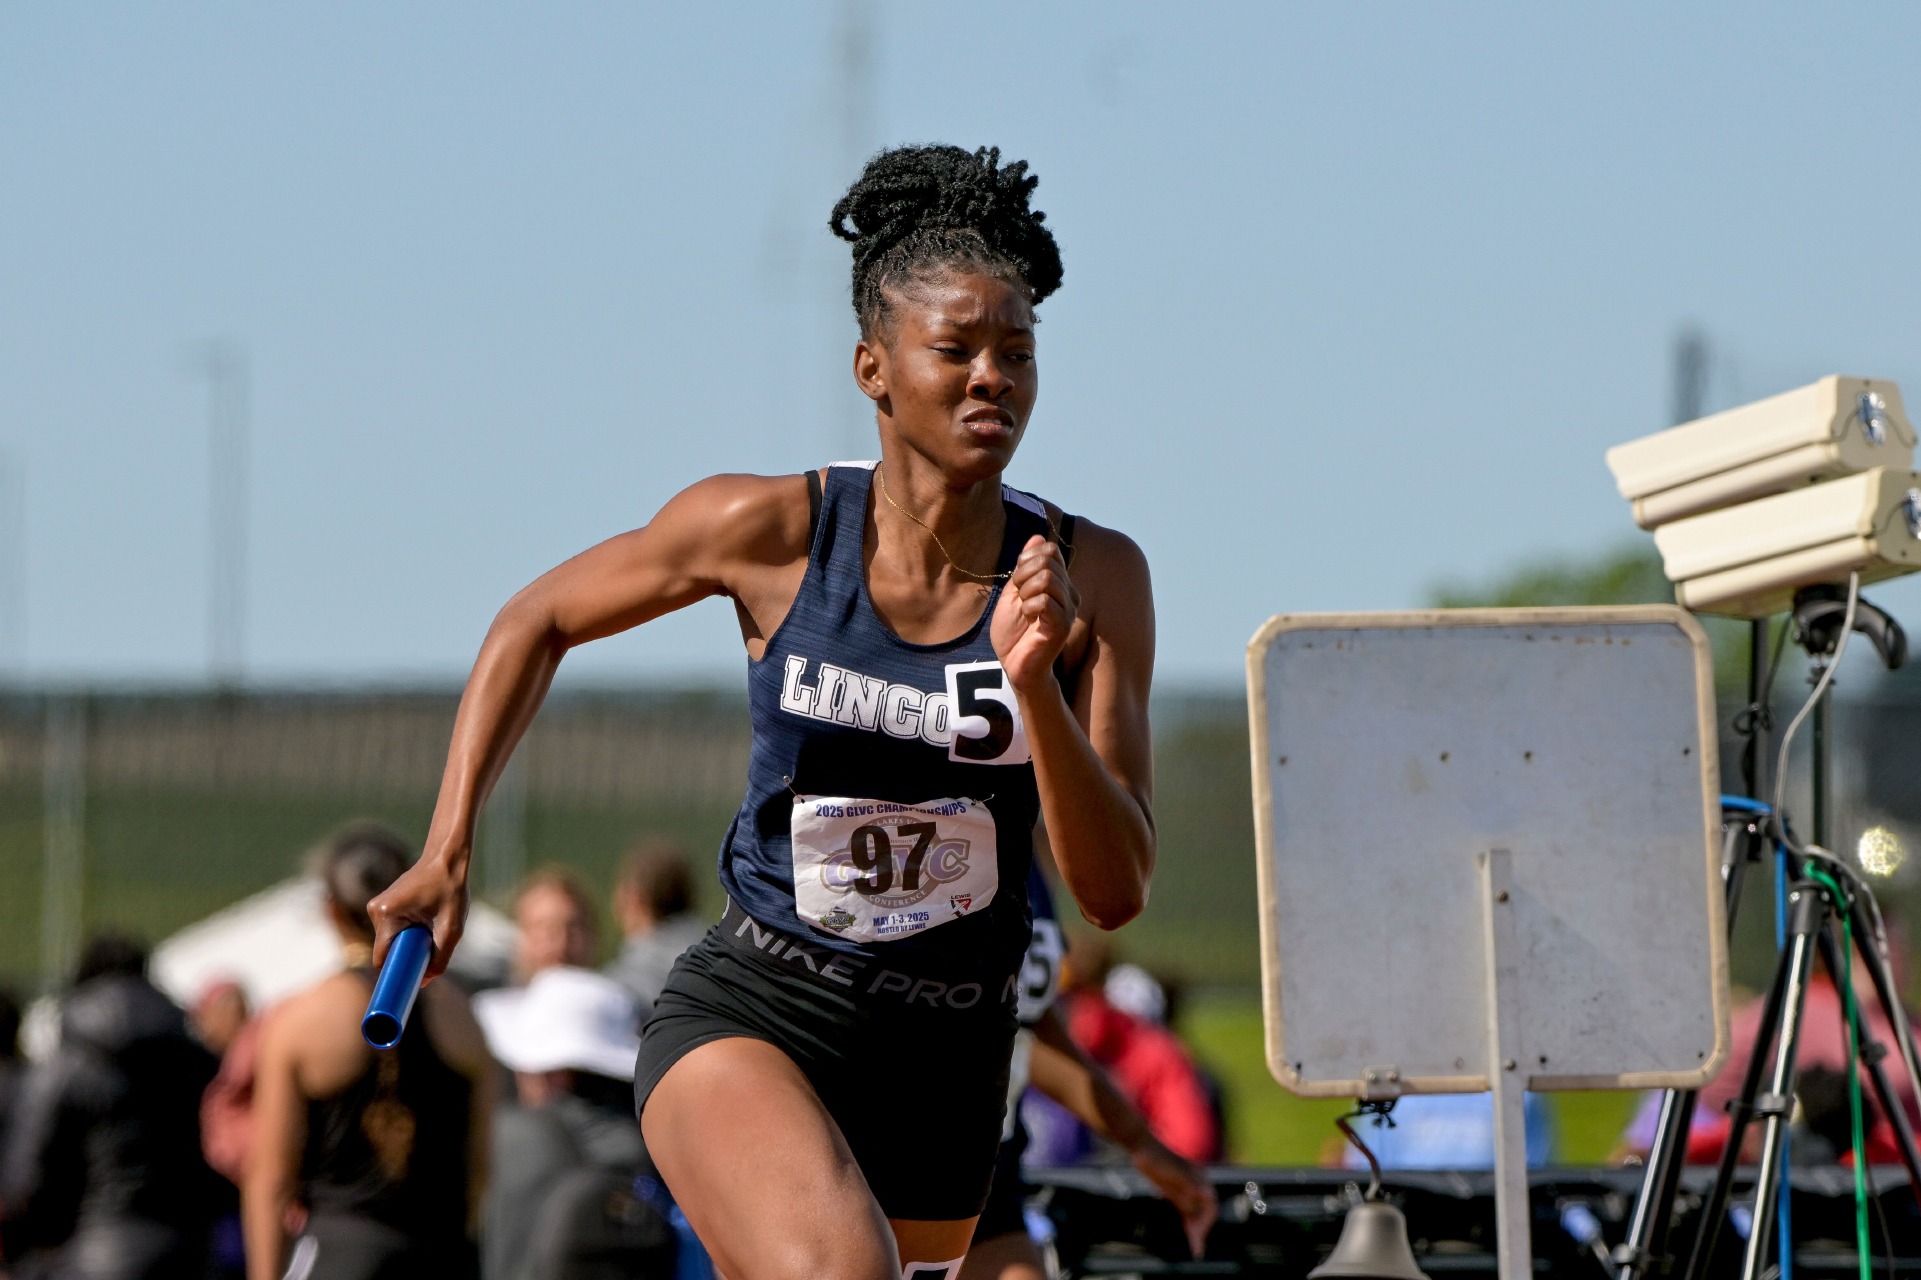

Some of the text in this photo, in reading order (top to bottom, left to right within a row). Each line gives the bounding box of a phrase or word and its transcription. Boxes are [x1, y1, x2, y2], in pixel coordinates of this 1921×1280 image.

[780, 655, 951, 748] LINCO
[955, 668, 1013, 760] 5
[816, 804, 843, 817] 2025
[846, 805, 874, 817] GLVC
[851, 822, 936, 895] 97
[869, 890, 927, 906] CONFERENCE
[873, 916, 889, 926] MAY
[908, 912, 929, 922] 2025
[877, 926, 899, 934] HOSTED
[909, 923, 926, 931] LEWIS
[734, 916, 867, 987] NIKE
[867, 970, 982, 1009] PRO
